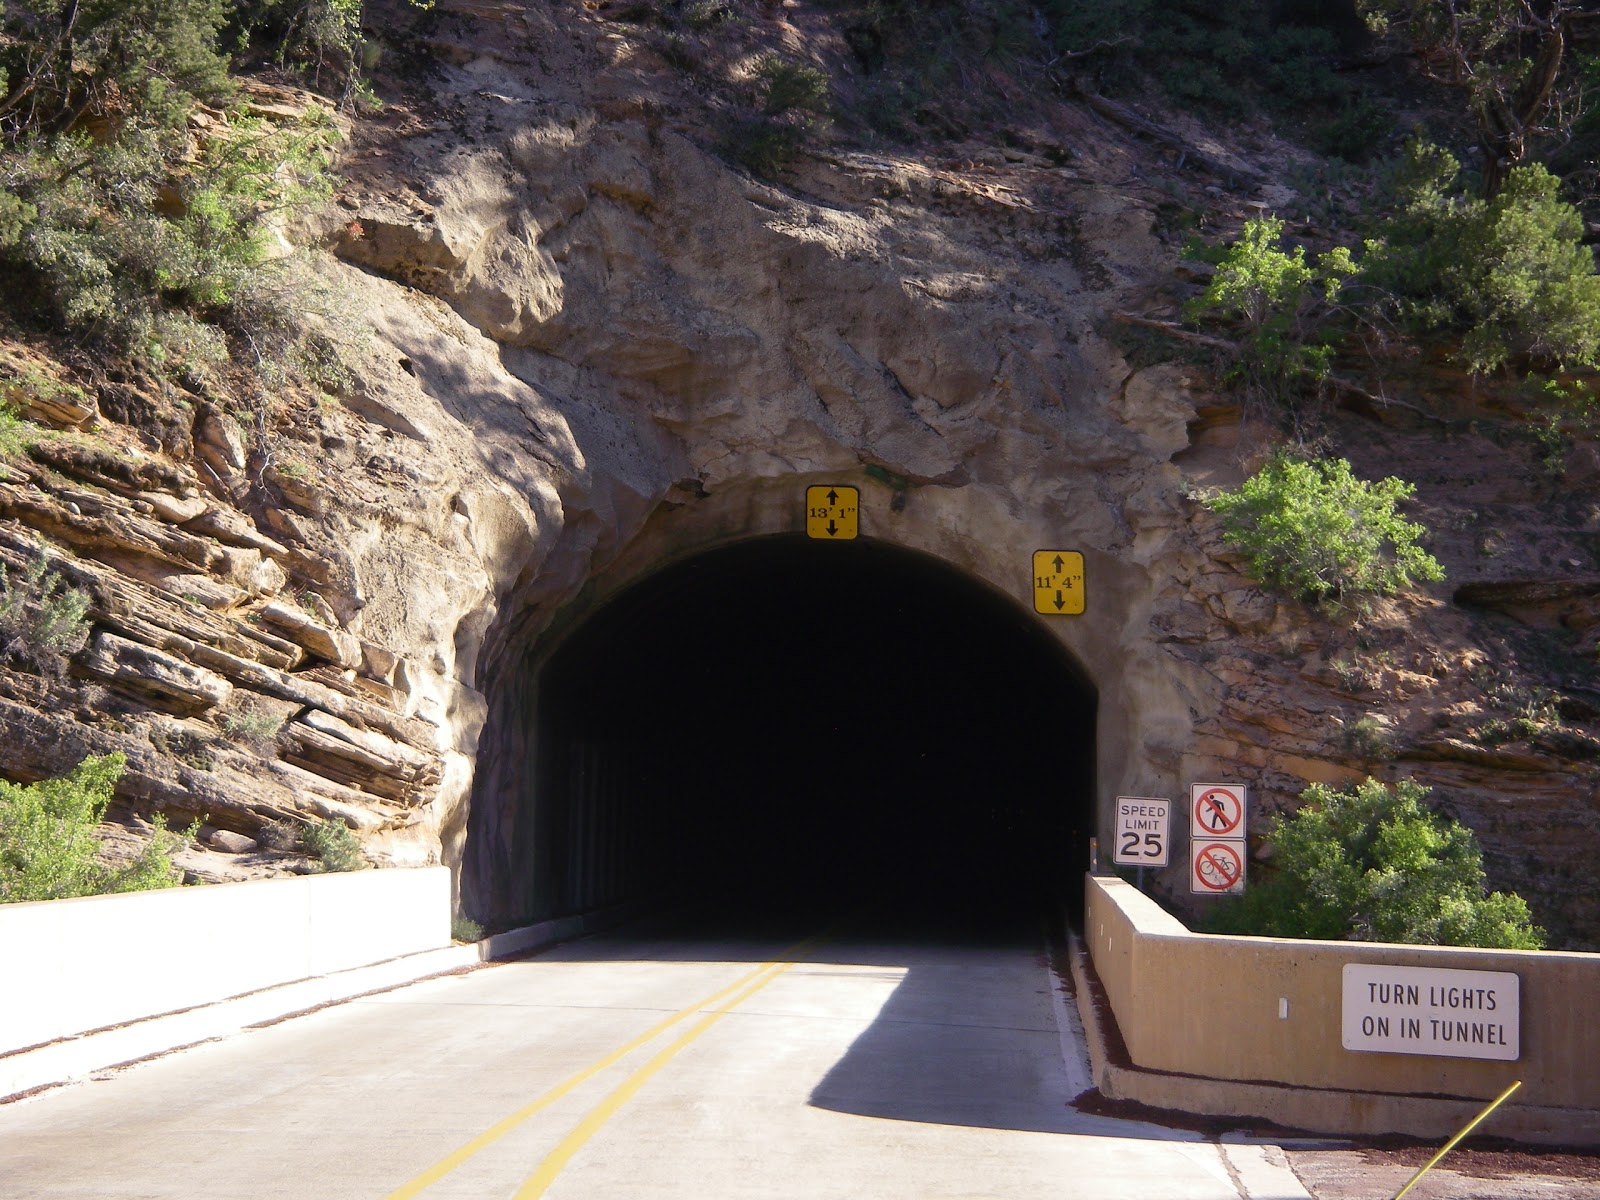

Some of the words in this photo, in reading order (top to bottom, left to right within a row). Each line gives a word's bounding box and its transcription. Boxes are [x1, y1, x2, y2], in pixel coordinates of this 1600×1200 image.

[1121, 805, 1166, 817] SPEED
[1125, 819, 1159, 831] LIMIT
[1120, 832, 1162, 857] 25
[1368, 982, 1419, 1006] TURN
[1430, 986, 1497, 1011] LIGHTS
[1362, 1015, 1389, 1037] ON
[1400, 1018, 1420, 1039] IN
[1430, 1020, 1507, 1046] TUNNEL
